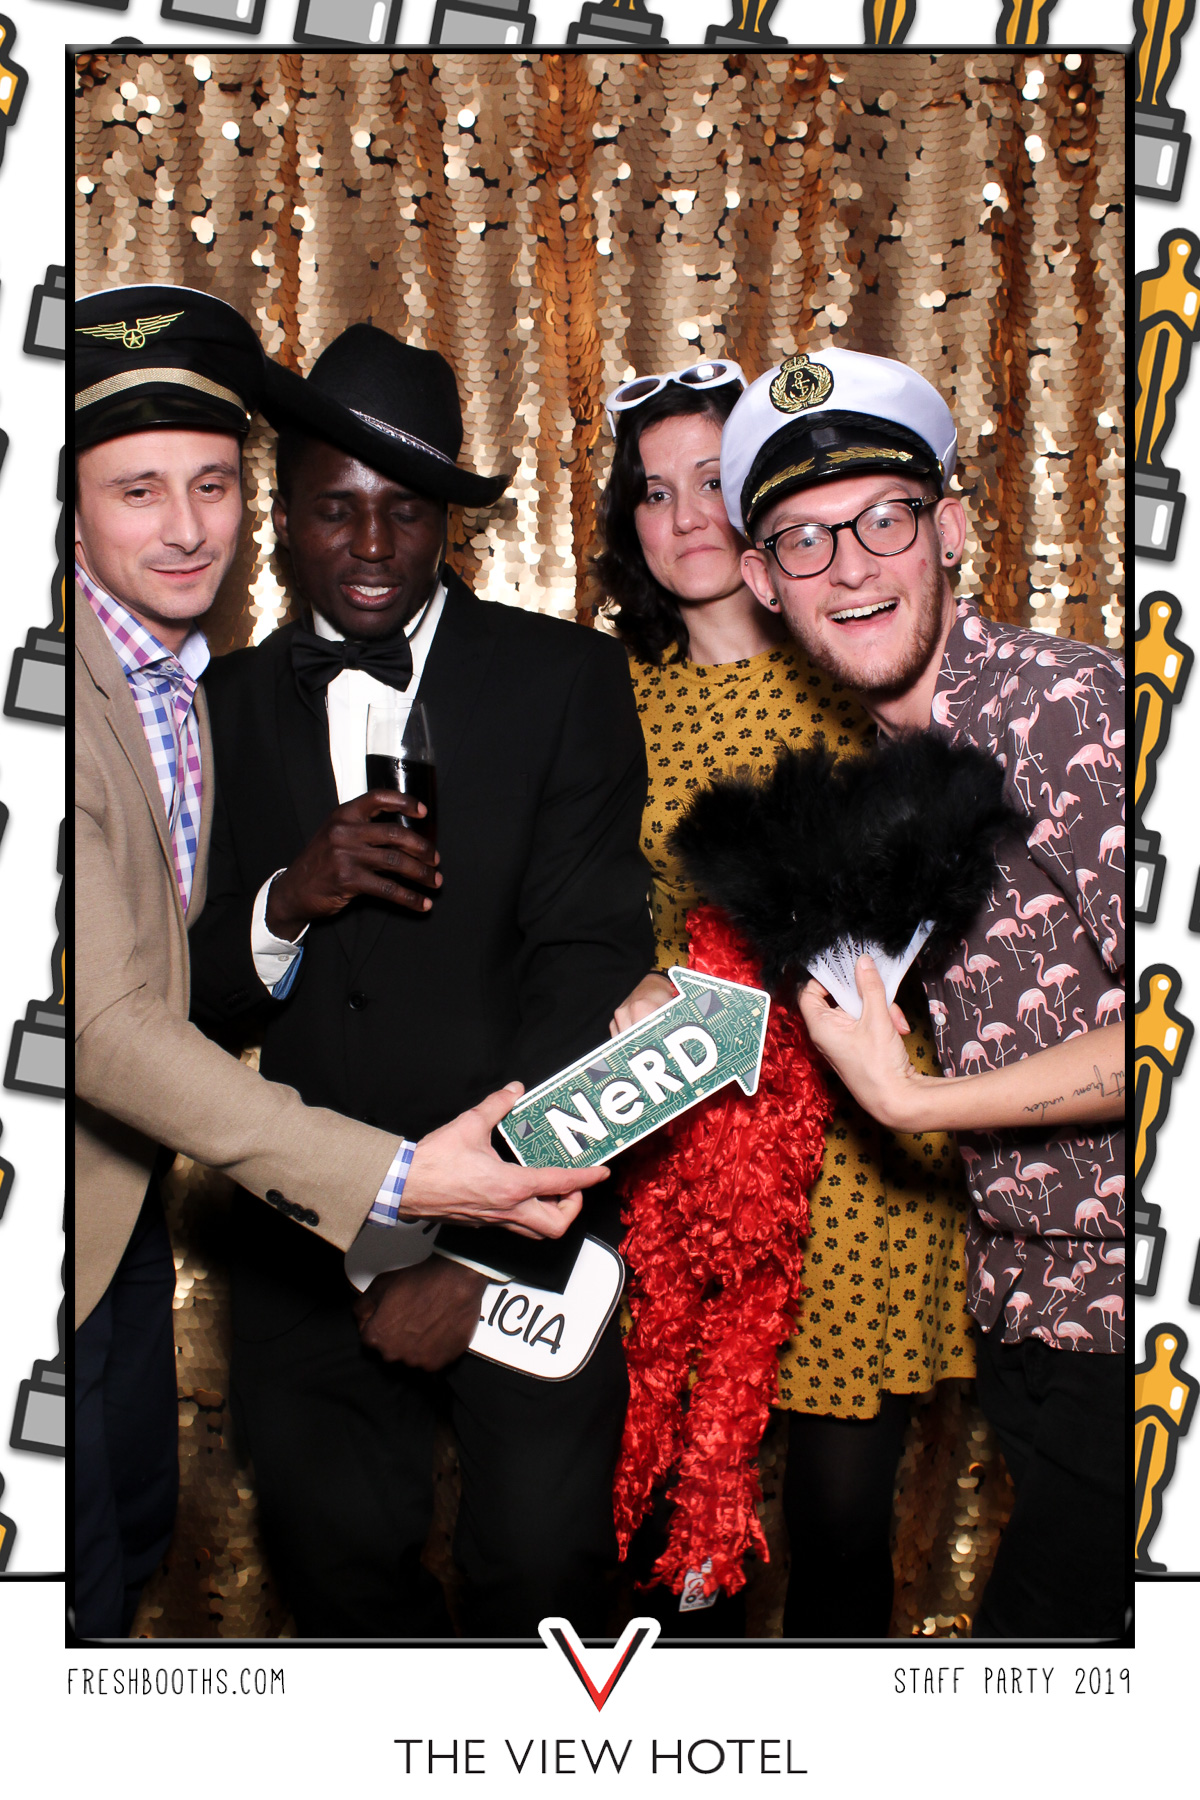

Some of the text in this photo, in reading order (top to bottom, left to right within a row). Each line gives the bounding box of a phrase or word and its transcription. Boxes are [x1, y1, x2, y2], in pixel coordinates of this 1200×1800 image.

[544, 1022, 719, 1159] NeRD
[1072, 1064, 1105, 1098] from
[1022, 1095, 1065, 1121] under
[479, 1288, 565, 1355] ICIA
